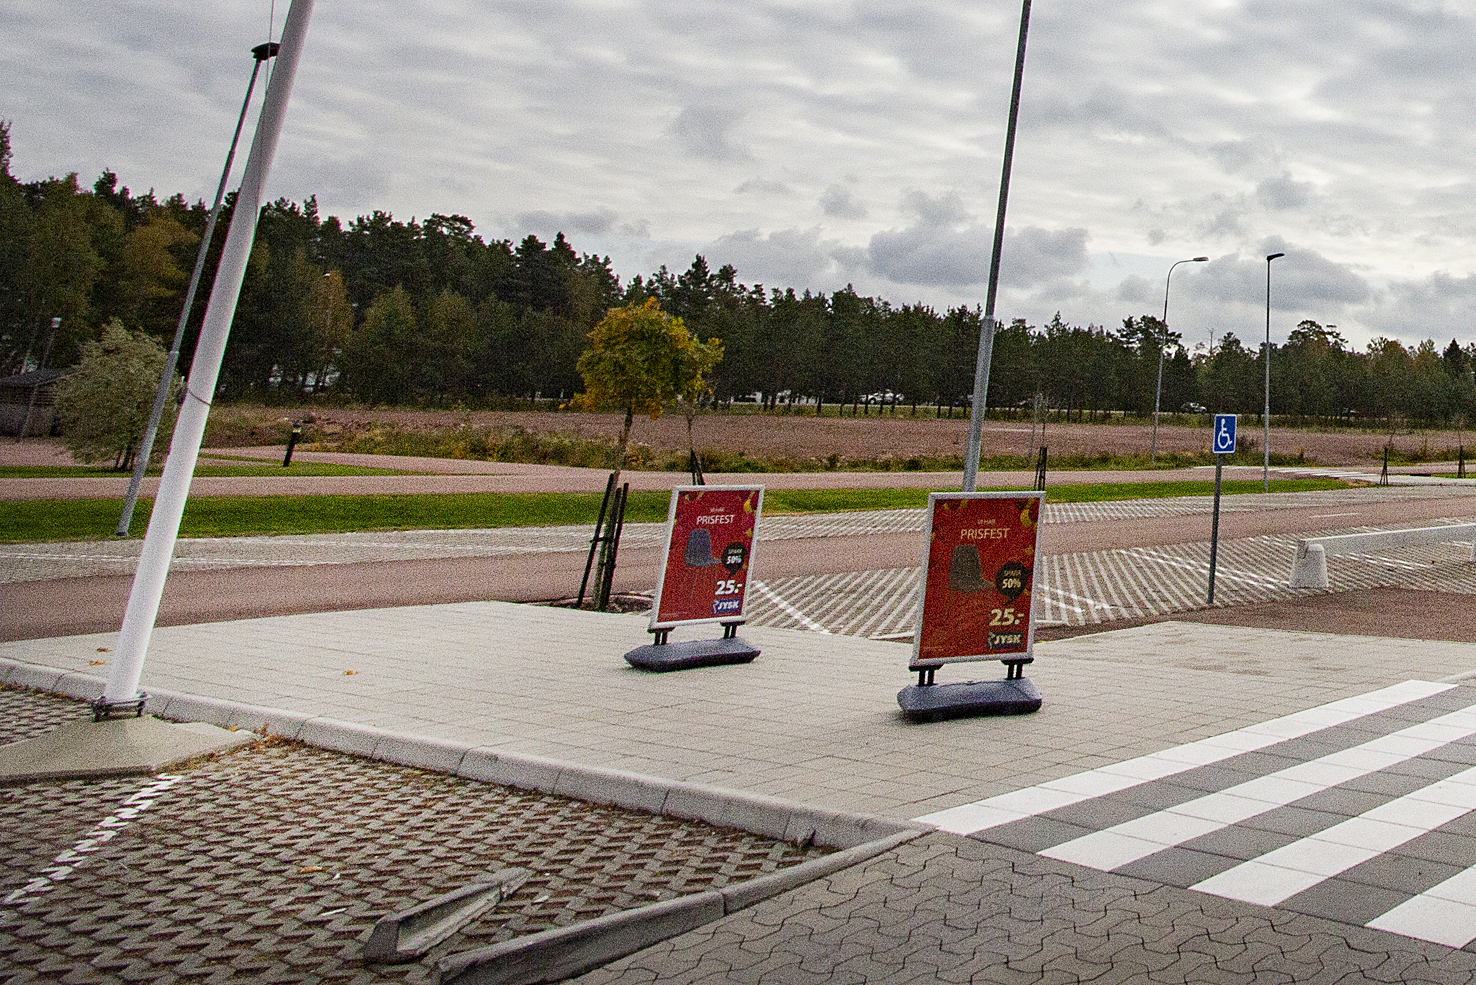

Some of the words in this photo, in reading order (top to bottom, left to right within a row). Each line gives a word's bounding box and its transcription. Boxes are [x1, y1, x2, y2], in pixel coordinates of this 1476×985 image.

[696, 514, 735, 525] PRISFEST
[960, 527, 1010, 539] PRISFEST
[1002, 578, 1021, 589] 50%
[717, 601, 740, 610] JYSK
[994, 633, 1022, 645] JYSK
